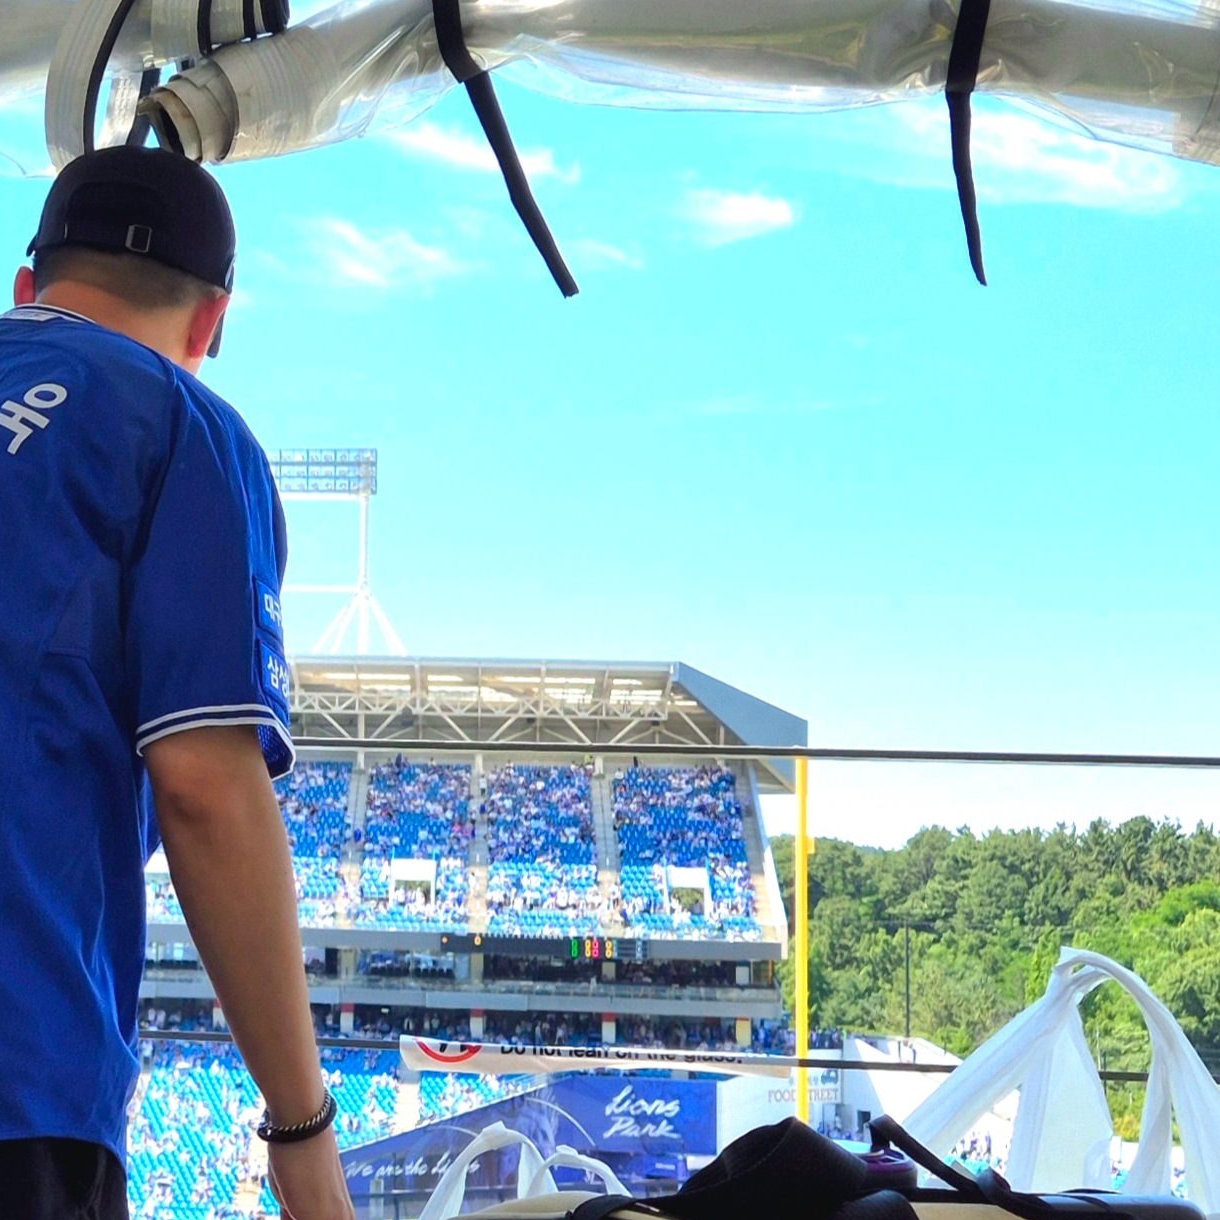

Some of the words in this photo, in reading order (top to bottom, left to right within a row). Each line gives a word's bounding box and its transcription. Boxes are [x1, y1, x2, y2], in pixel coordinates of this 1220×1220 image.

[605, 1085, 680, 1117] Lions
[805, 1087, 839, 1102] TREET
[603, 1116, 681, 1139] Park
[344, 1160, 373, 1179] We
[404, 1156, 428, 1176] the
[431, 1150, 480, 1177] Lis
